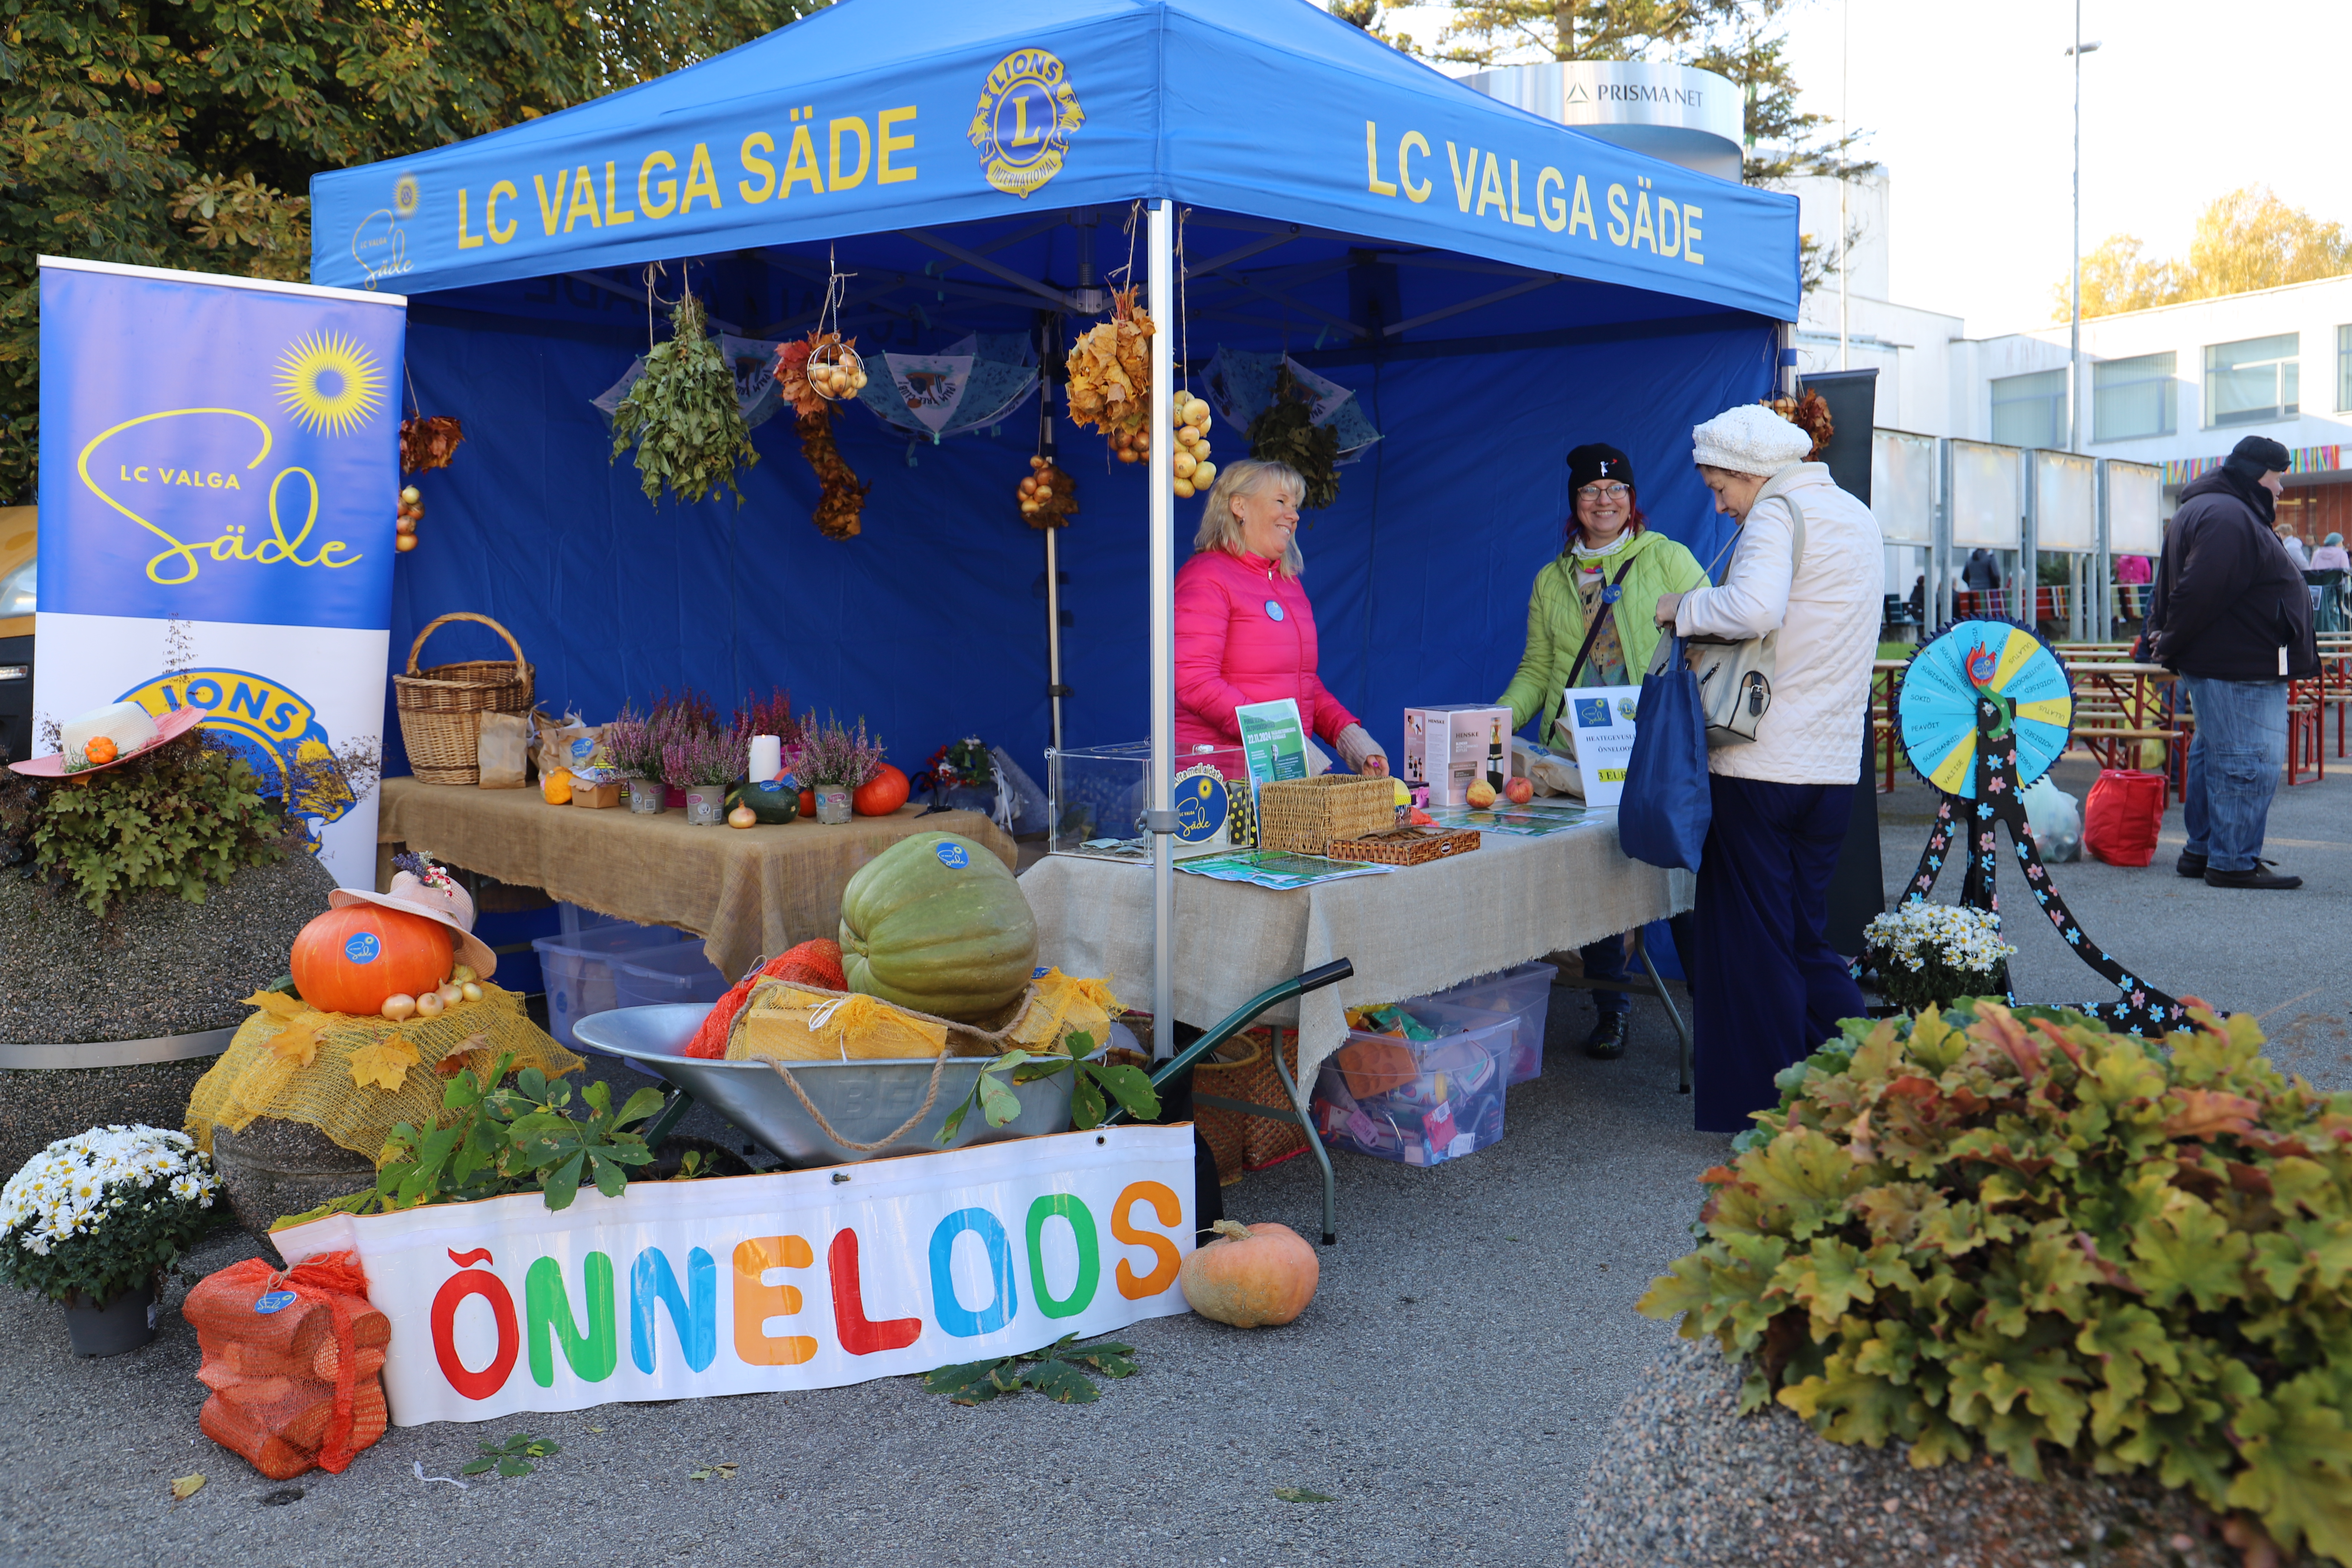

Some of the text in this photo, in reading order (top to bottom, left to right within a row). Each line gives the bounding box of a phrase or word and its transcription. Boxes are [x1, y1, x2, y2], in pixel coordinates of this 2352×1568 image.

[992, 53, 1059, 90] LIONS
[1598, 83, 1703, 107] PRISMA NET
[1011, 95, 1041, 147] L
[457, 105, 917, 250] LC VALGA SÄDE
[991, 156, 1057, 187] INTERNATIONAL
[1366, 120, 1704, 265] LC VALGA SÄDE
[352, 208, 414, 291] Säde
[898, 385, 916, 401] CLUB
[939, 386, 956, 402] PALM
[121, 464, 240, 490] LC VALGA
[78, 407, 363, 585] Säde
[1920, 665, 1957, 694] SÜGISANNID
[2024, 677, 2056, 694] HOIDISED
[136, 678, 300, 735] IONS
[1911, 694, 1931, 703] SOKID
[1248, 731, 1271, 744] 22.11.2024
[1911, 721, 1940, 732] PEAVÕIT
[2024, 729, 2054, 750] HOIDISED
[1923, 735, 1960, 763] SÜGISANNID
[1943, 759, 1964, 784] VALI ISE
[937, 849, 966, 866] Säde
[430, 1179, 1183, 1402] ÕNNELOOS
